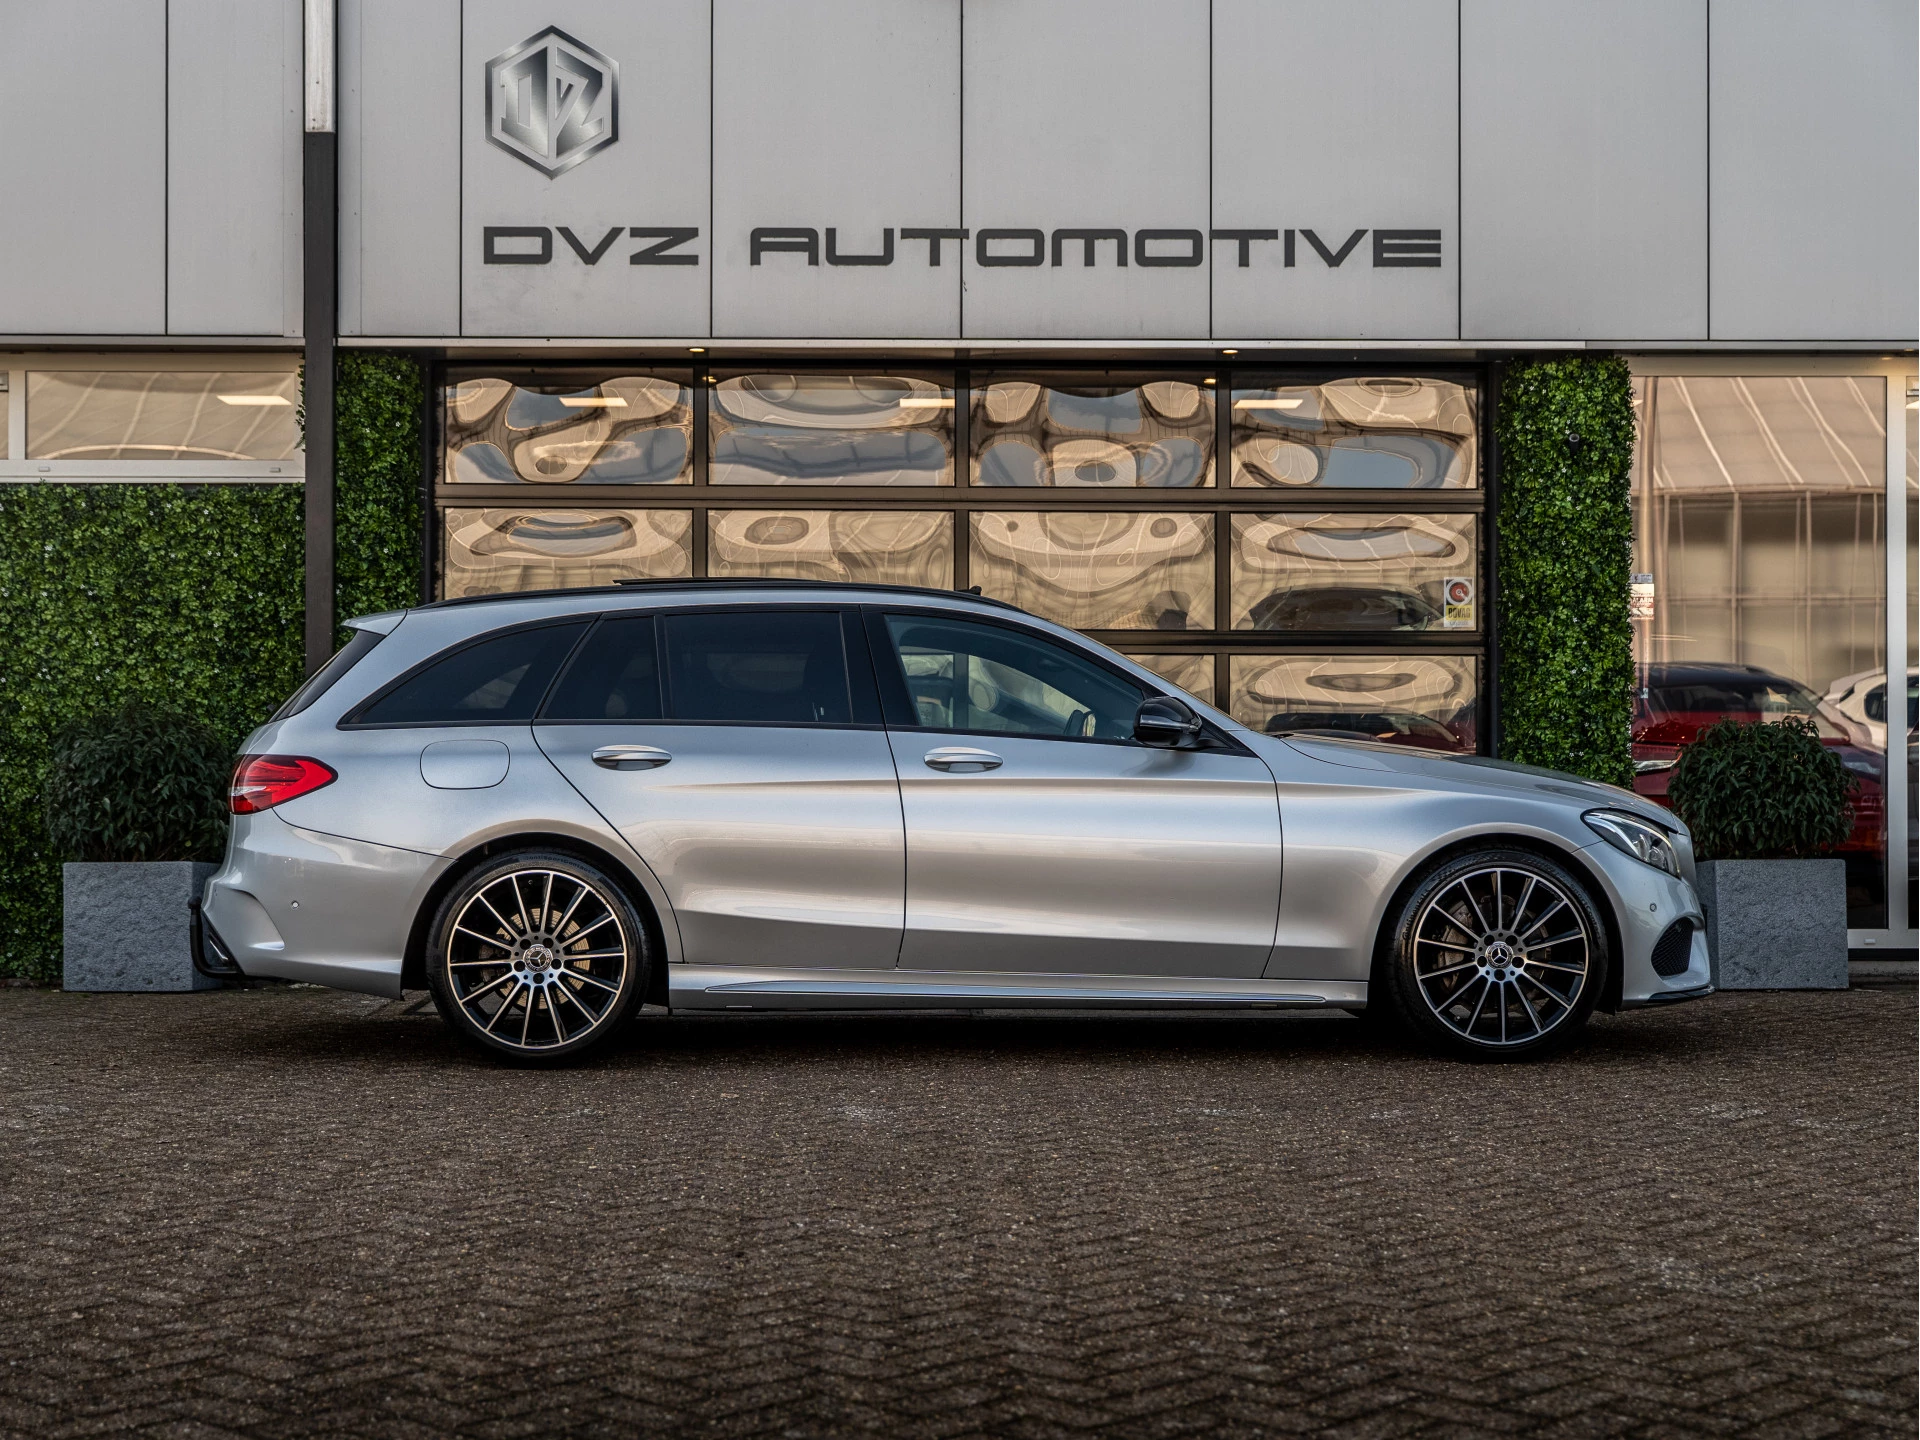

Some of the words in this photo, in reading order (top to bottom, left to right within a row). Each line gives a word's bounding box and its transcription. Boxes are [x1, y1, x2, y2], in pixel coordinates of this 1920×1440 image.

[484, 227, 699, 265] DVZ
[751, 228, 1442, 268] AUTOMOTIVE
[1448, 607, 1471, 619] BOVAG
